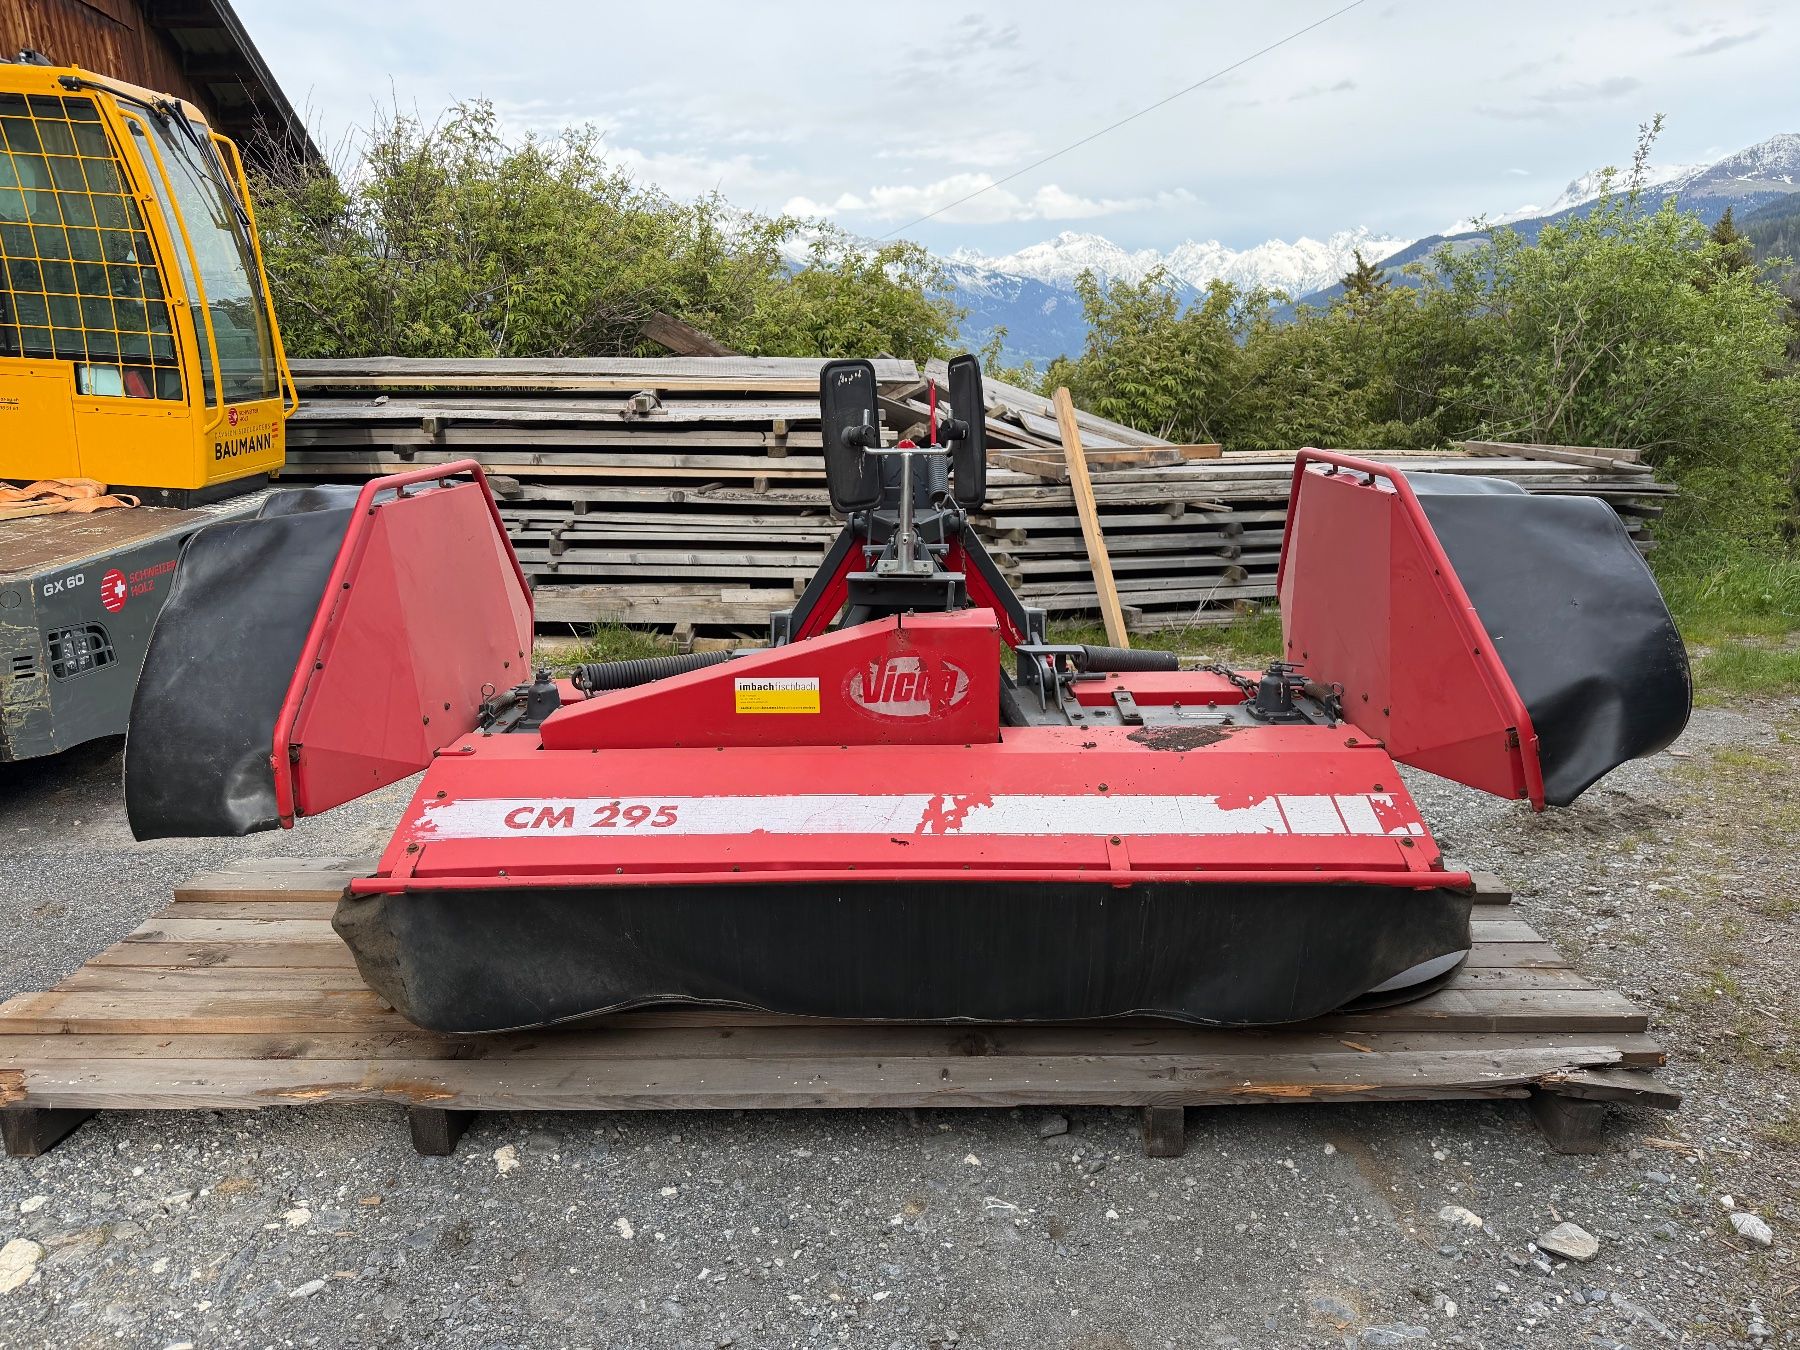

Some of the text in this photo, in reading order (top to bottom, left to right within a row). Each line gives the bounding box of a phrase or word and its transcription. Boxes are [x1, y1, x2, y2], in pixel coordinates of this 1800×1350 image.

[215, 432, 271, 461] BAUMANN
[43, 573, 85, 597] GX 60
[130, 579, 156, 597] HOLZ
[504, 804, 679, 829] CM 295
